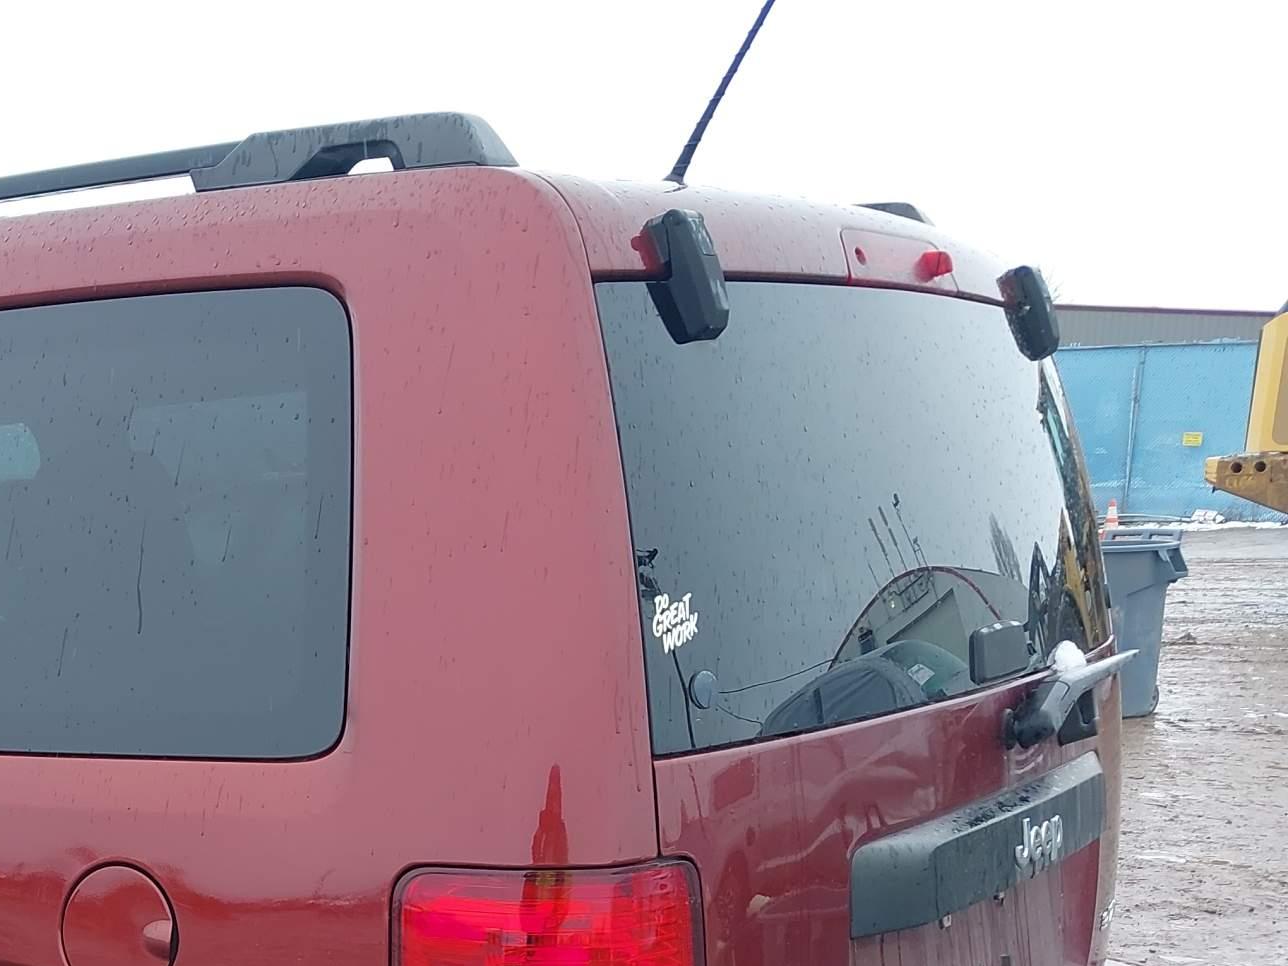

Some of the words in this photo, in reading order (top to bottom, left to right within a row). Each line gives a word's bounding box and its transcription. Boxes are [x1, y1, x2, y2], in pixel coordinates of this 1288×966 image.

[652, 593, 692, 638] GREAT
[654, 593, 669, 614] DO
[662, 612, 699, 654] WORK
[1015, 814, 1064, 864] Jeep
